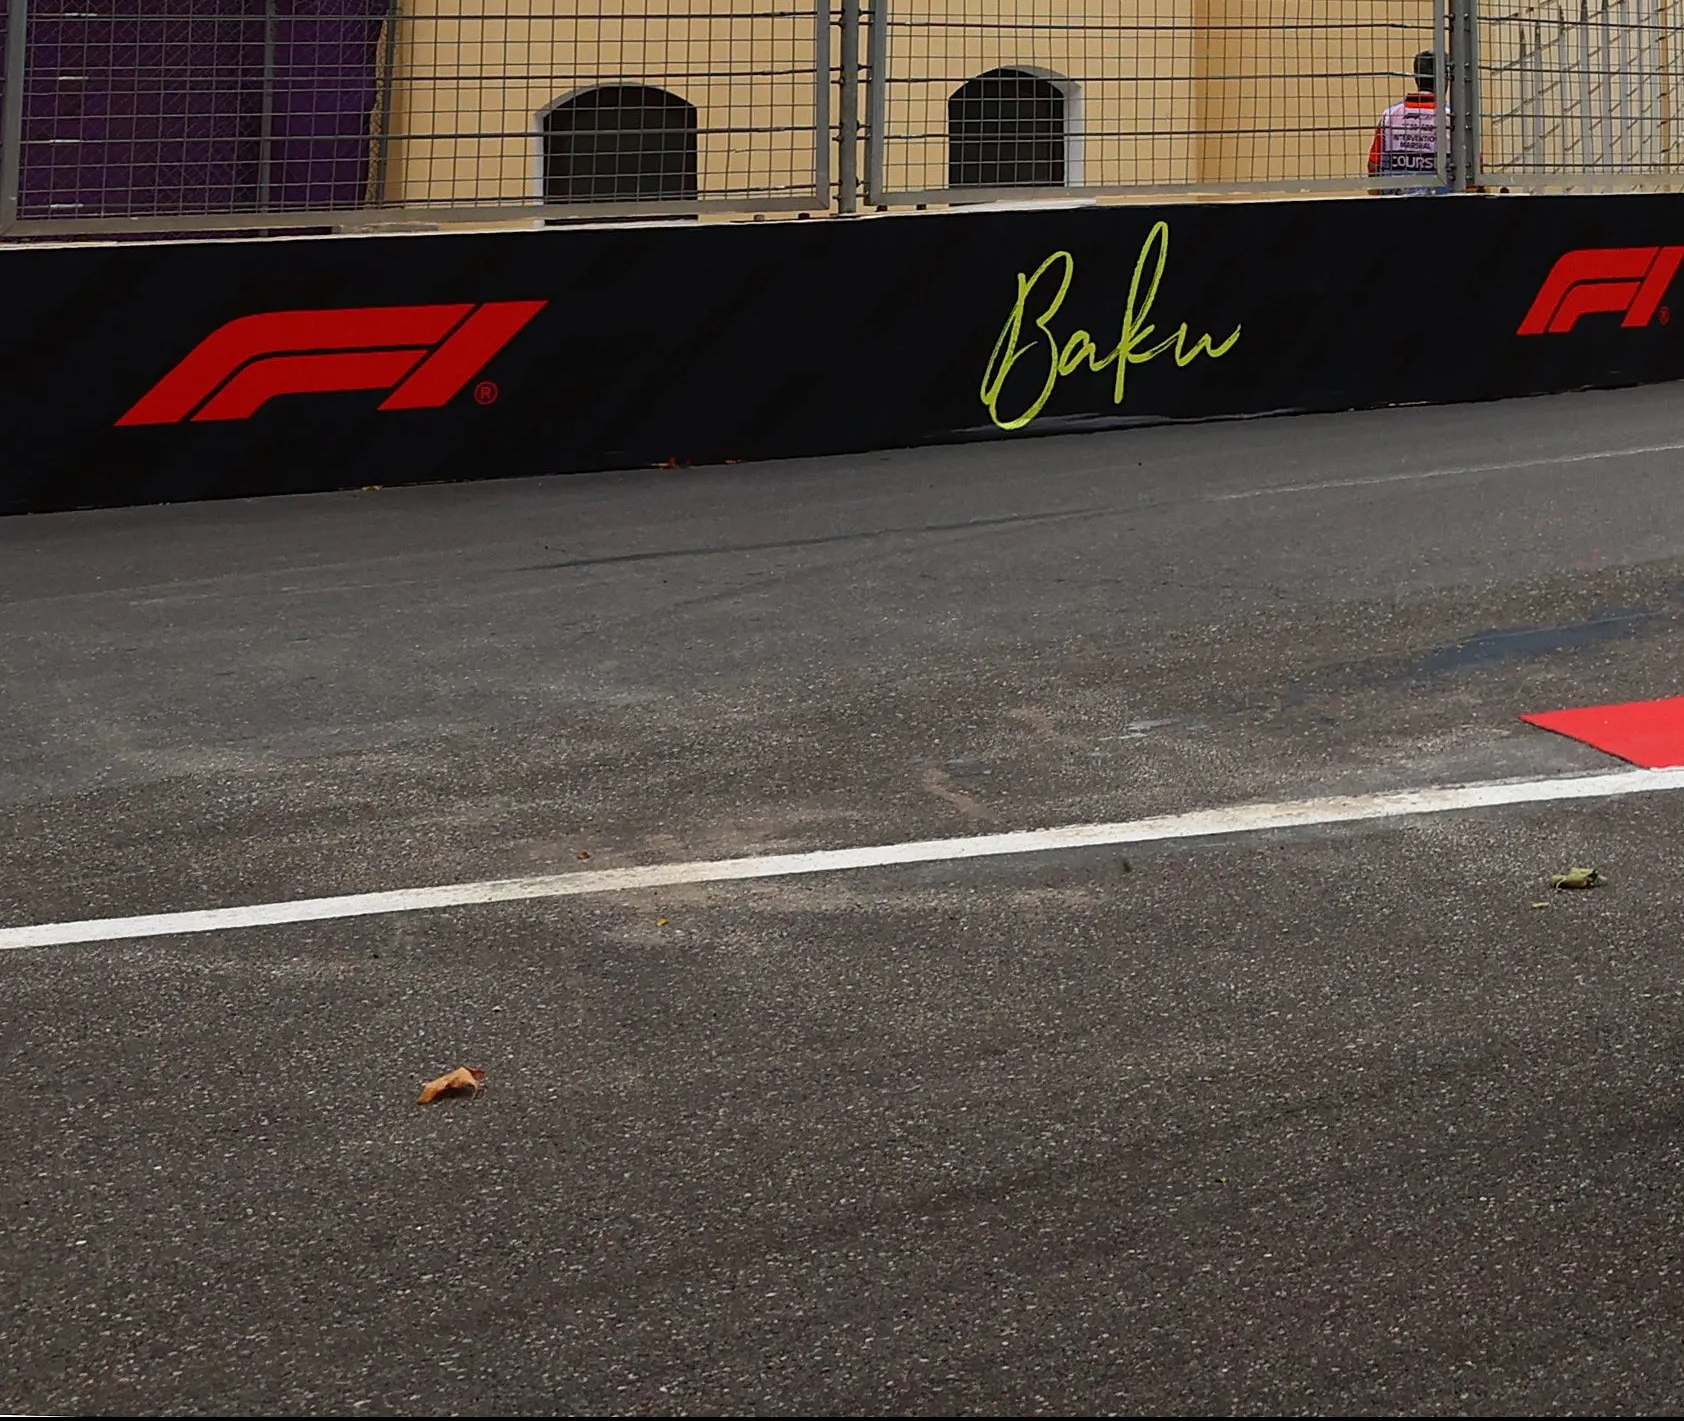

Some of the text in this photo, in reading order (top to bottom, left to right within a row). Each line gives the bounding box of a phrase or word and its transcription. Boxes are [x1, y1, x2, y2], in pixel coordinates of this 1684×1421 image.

[1392, 155, 1437, 169] COURS
[114, 300, 548, 427] F1
[979, 220, 1242, 430] Baku
